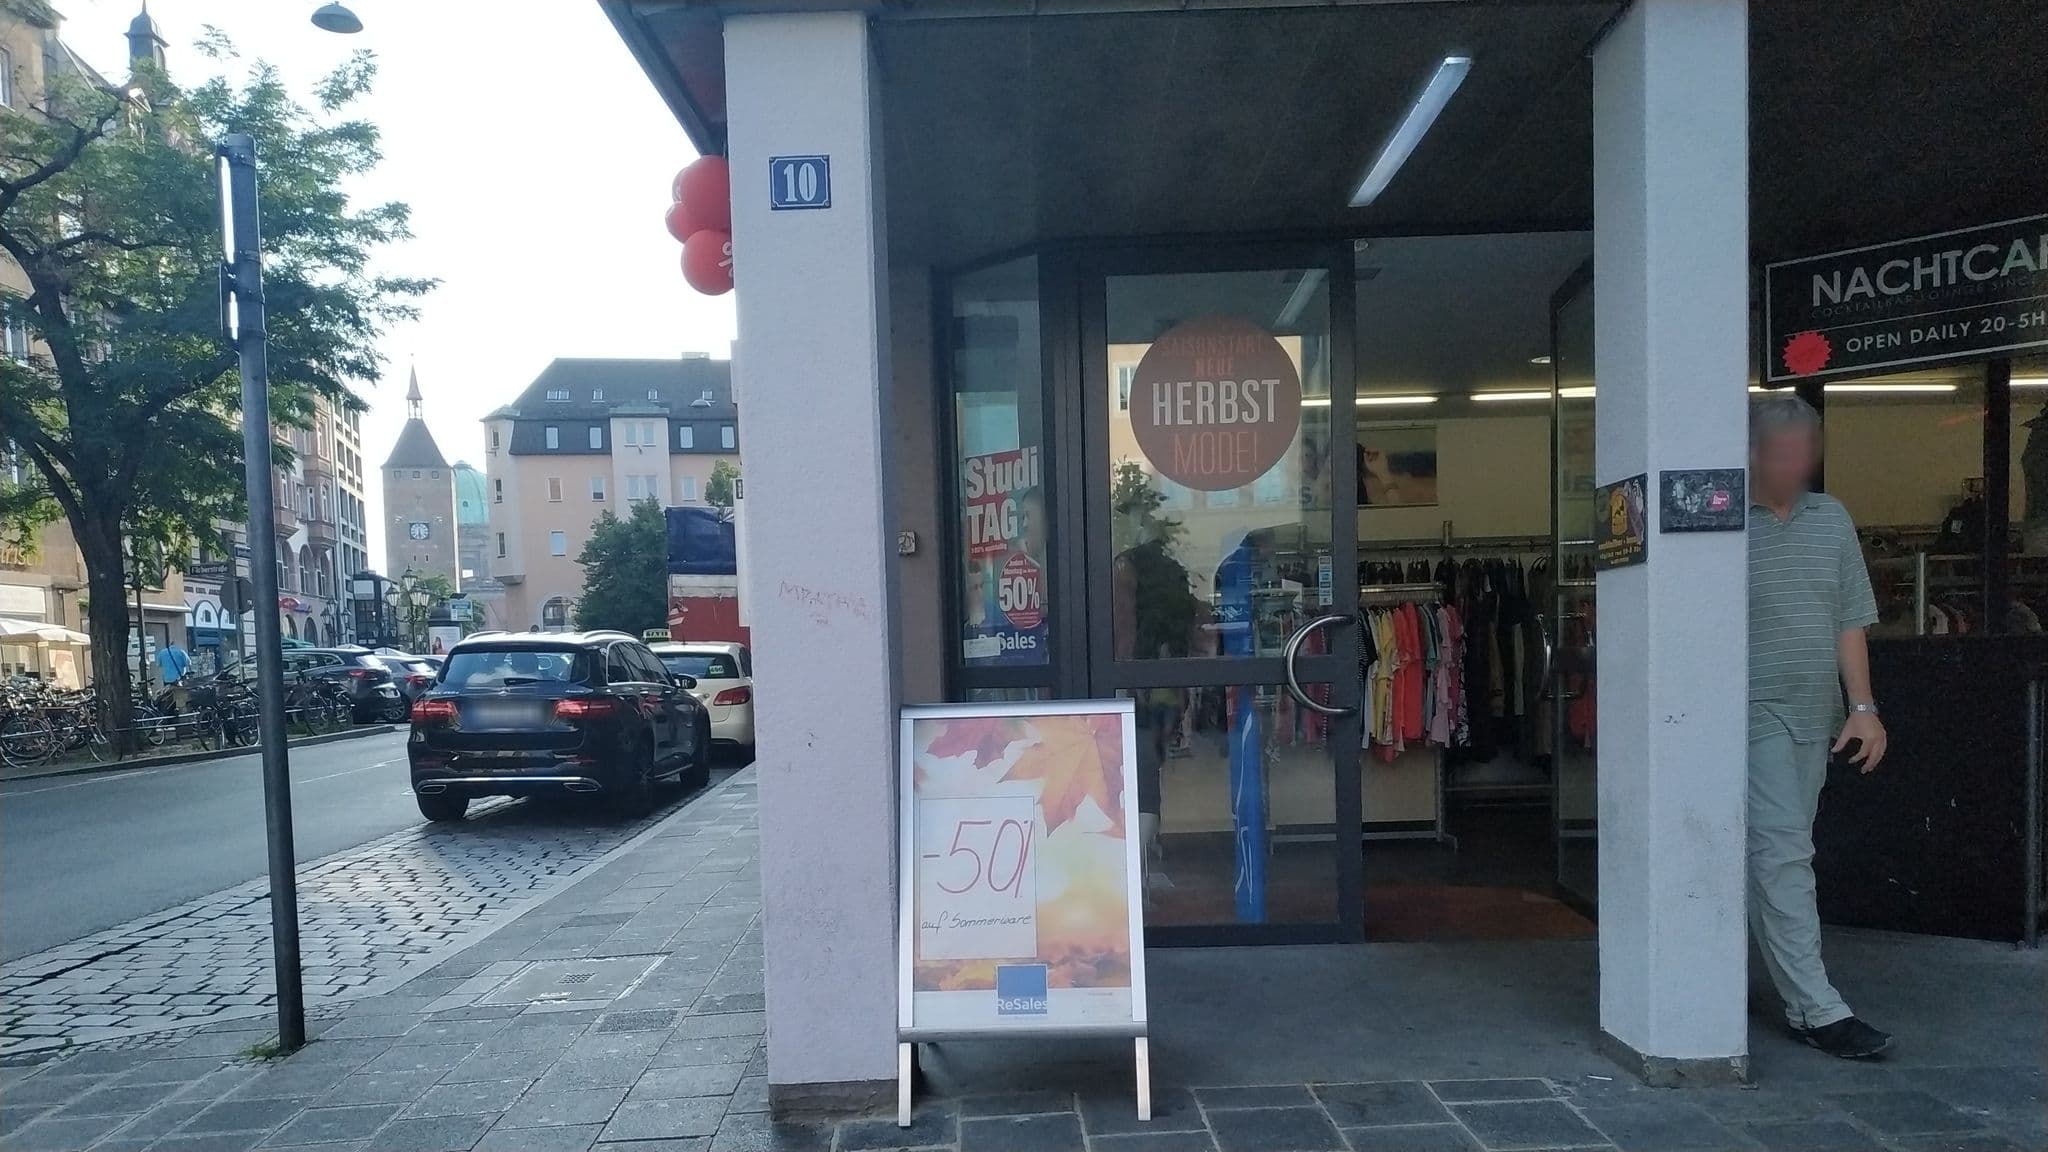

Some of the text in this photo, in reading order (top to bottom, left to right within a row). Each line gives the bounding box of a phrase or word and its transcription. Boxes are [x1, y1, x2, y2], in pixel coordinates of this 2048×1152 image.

[783, 162, 818, 202] 10
[1846, 332, 1901, 353] OPEN
[1910, 321, 1972, 344] DAILY
[1153, 379, 1280, 426] HERBST
[966, 446, 1038, 498] Studi
[1174, 431, 1257, 475] MODE!
[967, 498, 1018, 544] TAG
[999, 576, 1040, 612] 50%
[978, 632, 1037, 651] Sales
[921, 910, 1033, 934] auf Sommerware
[997, 997, 1048, 1011] ReSales
